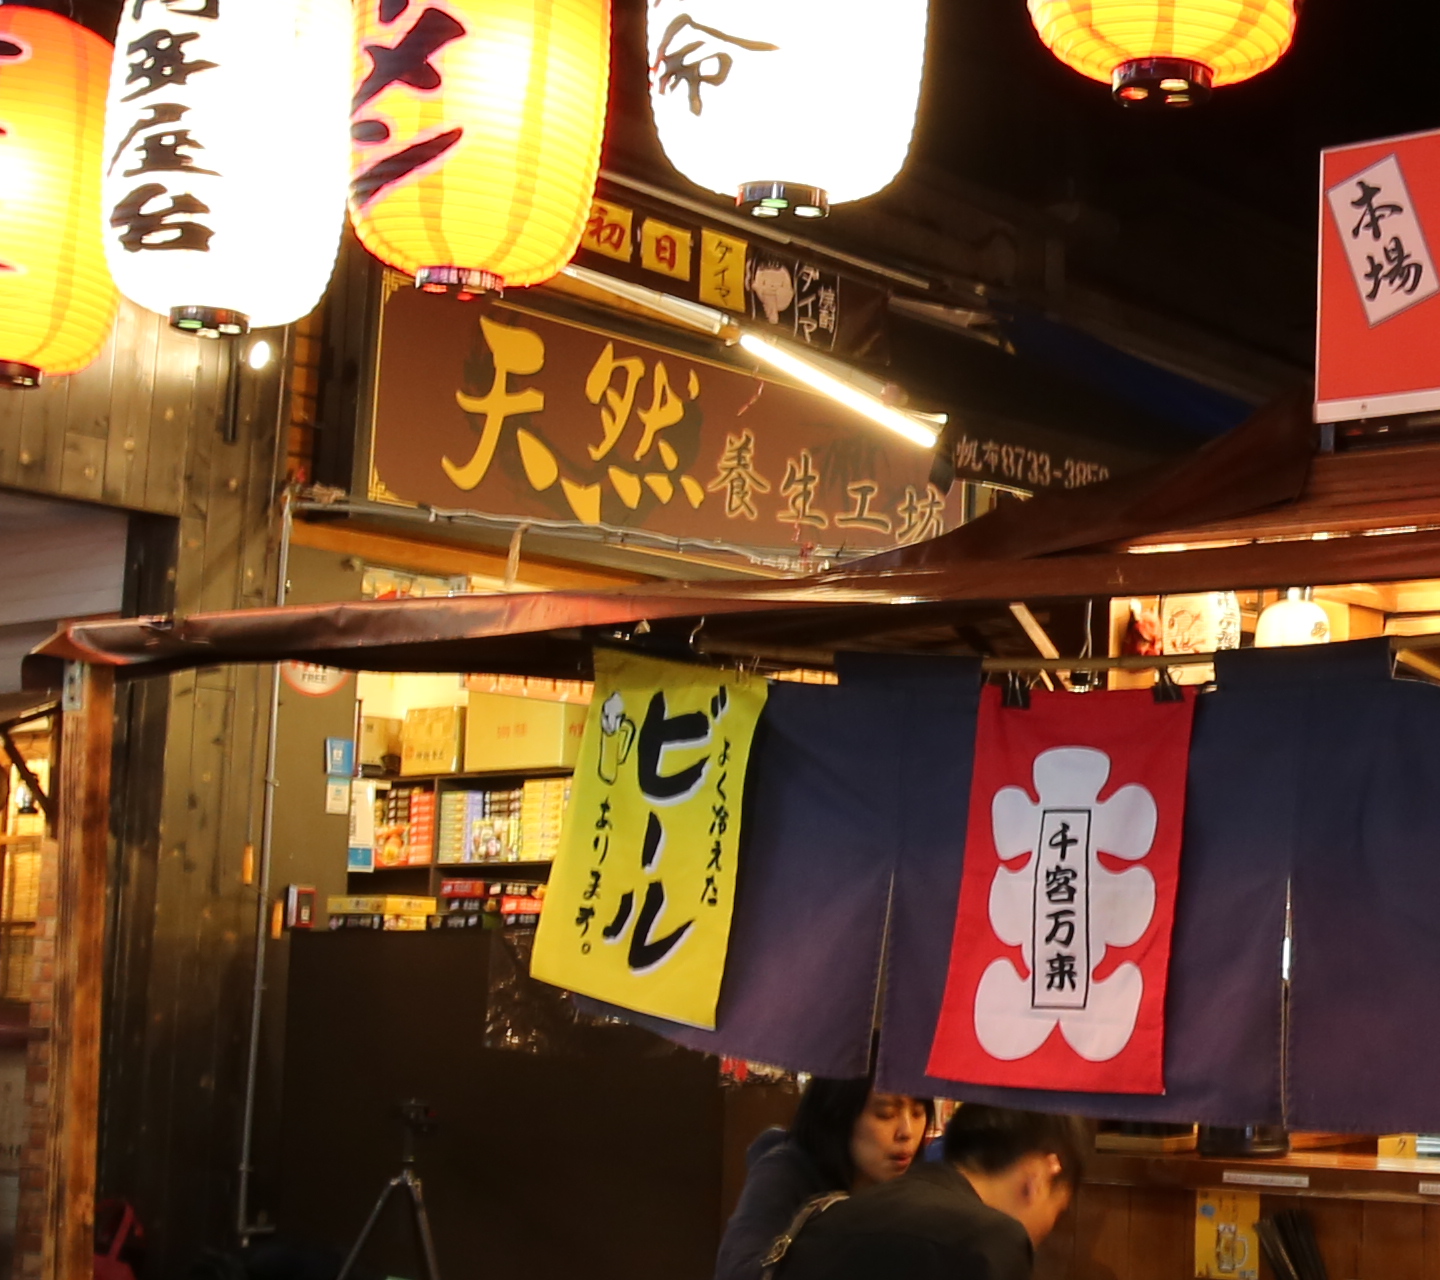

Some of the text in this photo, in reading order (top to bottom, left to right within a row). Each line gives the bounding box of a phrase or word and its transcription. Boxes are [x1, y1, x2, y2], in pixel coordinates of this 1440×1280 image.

[1351, 179, 1423, 304] 本場
[441, 317, 946, 544] 天然 養生工坊
[603, 686, 730, 972] ビール
[701, 736, 731, 905] よく冷えた
[1044, 822, 1080, 992] 千客万来
